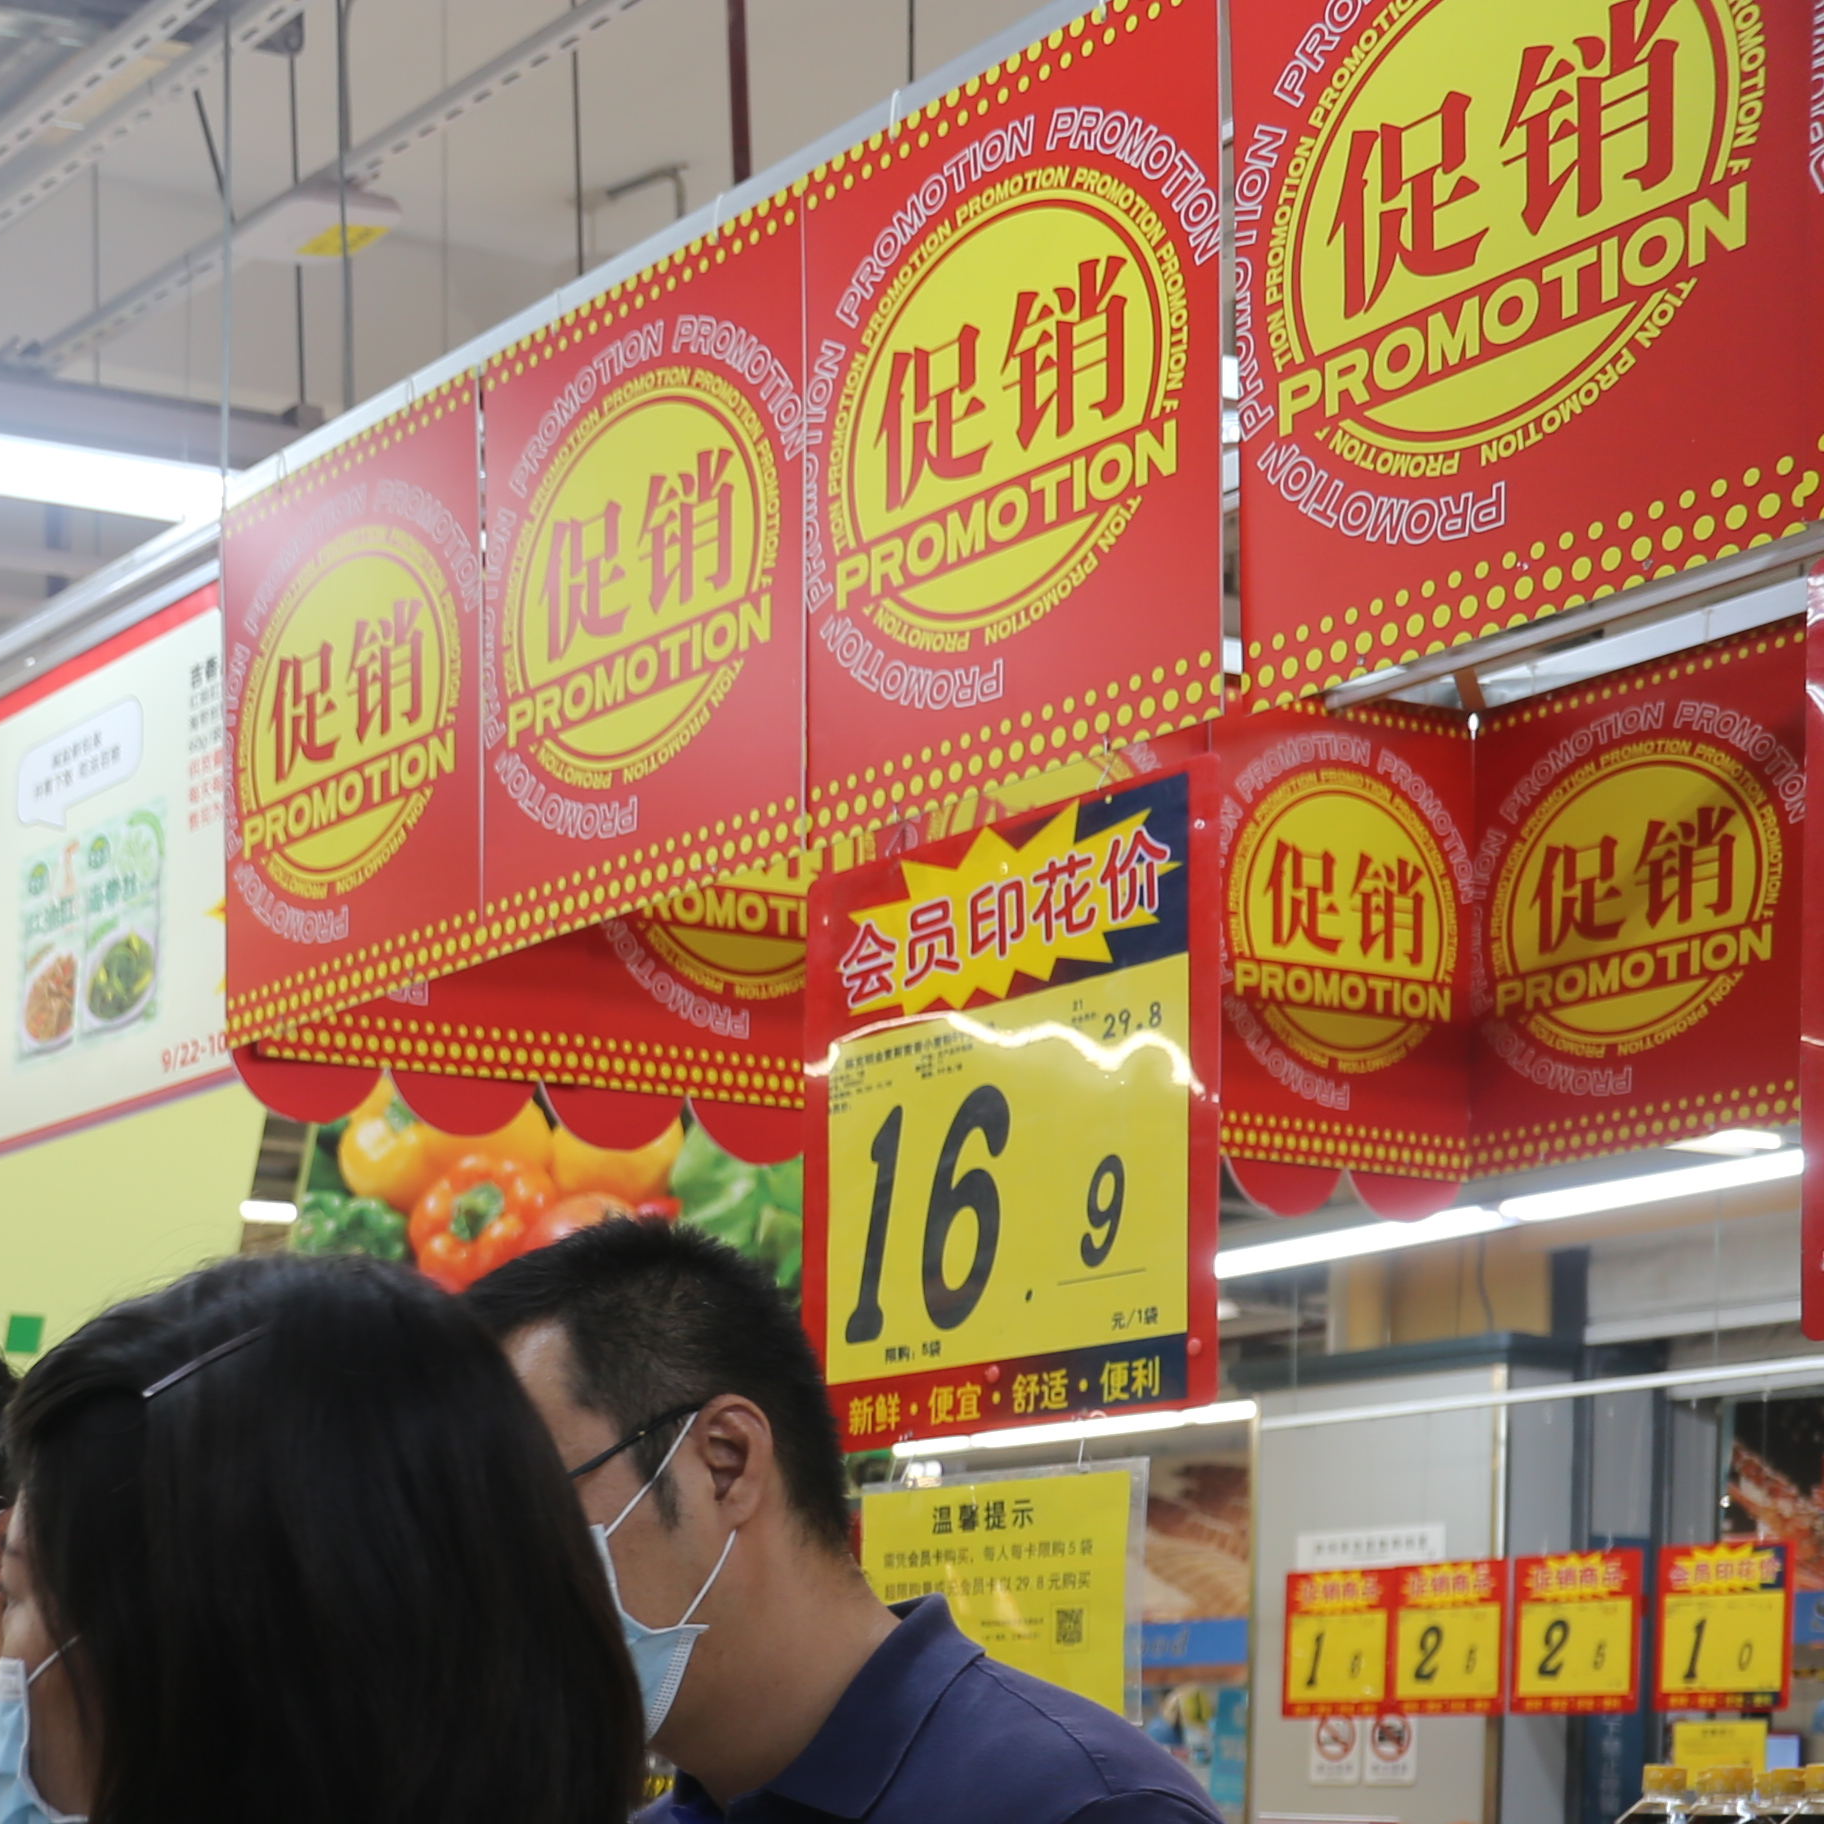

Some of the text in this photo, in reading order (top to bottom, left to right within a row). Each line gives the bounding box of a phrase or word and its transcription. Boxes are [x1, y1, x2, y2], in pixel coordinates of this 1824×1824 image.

[1310, 0, 1418, 130] PROMOTIO
[1728, 0, 1766, 146] ROMOTION
[836, 115, 1034, 329] PROMOTION
[954, 165, 1070, 230] PROMOTION
[1047, 106, 1222, 265] PROMOTION
[1072, 167, 1167, 244] PROMOTION
[1265, 135, 1317, 306] PROMOTION
[1327, 0, 1679, 321] 促销
[861, 218, 953, 348] PROMOTION
[1156, 241, 1189, 396] PROMOTION
[1234, 123, 1288, 441] PROMOTION
[1278, 181, 1747, 437] PROMOTION
[509, 320, 665, 497] PROMOTION
[600, 366, 692, 420] PROMOTION
[672, 314, 808, 460] PROMOTION
[692, 366, 764, 439] PROMOTION
[828, 352, 867, 499] PROMOTION
[873, 255, 1128, 514] 促销
[1480, 348, 1636, 466] PROMOTION
[836, 418, 1178, 611] PROMOTION
[1256, 441, 1506, 545] PROMOTION
[1328, 433, 1462, 478] PROMOTION
[537, 448, 736, 665] 促销
[983, 552, 1100, 646] PROMOTION
[268, 597, 425, 782] 促销
[507, 594, 772, 749] PROMOTION
[819, 614, 1004, 710] PROMOTION
[873, 607, 970, 653] PROMOTION
[243, 730, 455, 862] PROMOTION
[496, 750, 638, 840] PROMOTION
[623, 706, 711, 784] PROMOTION
[1234, 731, 1372, 802] PROMOTION
[1500, 701, 1665, 823] PROMOTION
[1674, 700, 1808, 825] PROMOTION
[1377, 748, 1475, 906] PROMOTION
[1530, 806, 1736, 957] 促销
[235, 859, 349, 944] PROMOTION
[642, 887, 807, 937] ROMOTI
[838, 822, 1171, 1008] 会员印花价
[1265, 839, 1426, 967] 促销
[1102, 1001, 1162, 1039] 29.8
[1234, 958, 1452, 1022] PROMOTION
[1496, 923, 1773, 1018] PROMOTION
[932, 1499, 1034, 1534] 温馨提示
[1306, 1632, 1325, 1688] 1
[1413, 1625, 1444, 1683] 2
[1537, 1619, 1570, 1678] 2
[1682, 1618, 1707, 1683] 1
